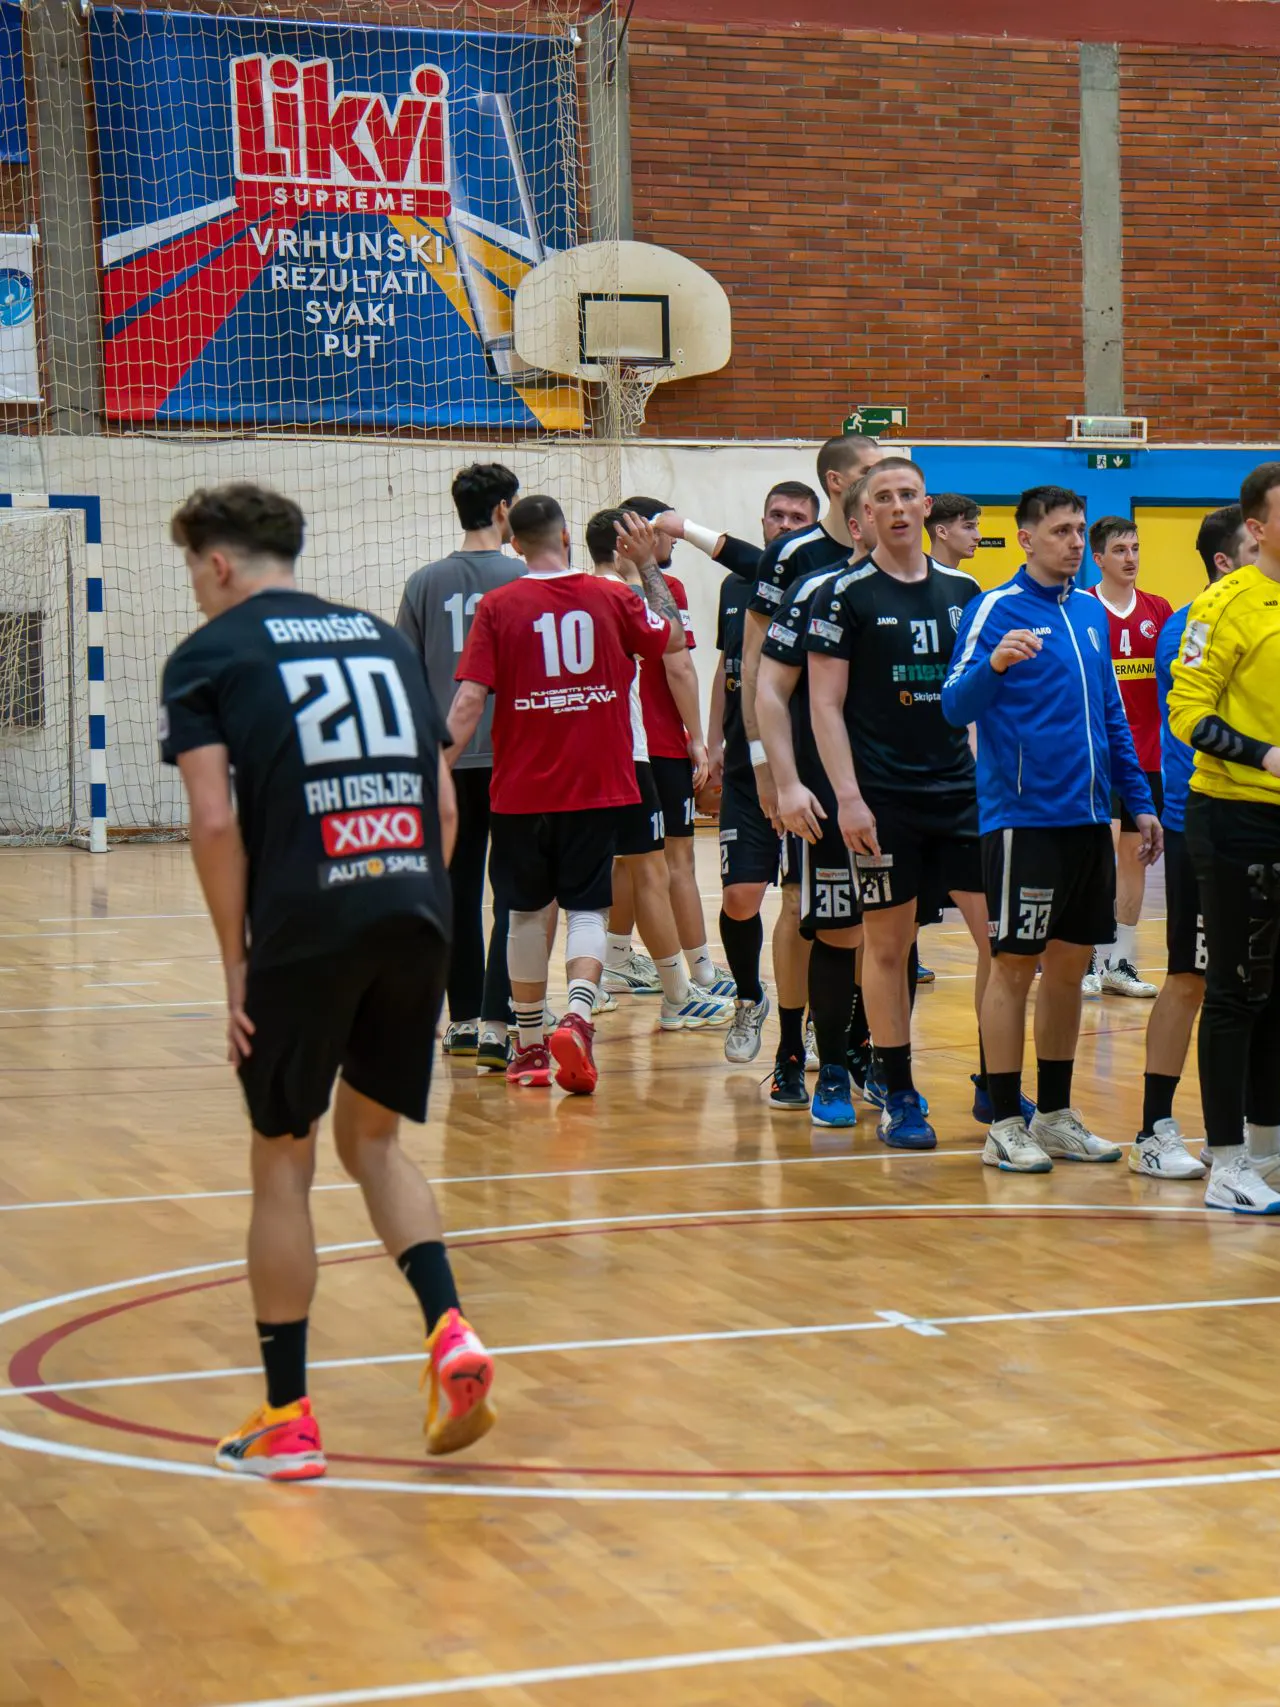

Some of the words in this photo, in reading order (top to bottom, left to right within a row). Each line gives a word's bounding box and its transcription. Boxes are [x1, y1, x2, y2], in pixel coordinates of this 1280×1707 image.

[273, 187, 416, 212] SUPREME
[250, 227, 445, 264] VRHUNSKI
[271, 266, 428, 296] REZULTATI
[305, 300, 396, 327] SVAKI
[323, 333, 382, 360] PUT
[877, 617, 899, 626] JAKO
[910, 619, 940, 654] 31
[533, 609, 595, 678] 10
[1119, 628, 1132, 656] 4
[907, 664, 950, 682] nex
[278, 656, 420, 766] 20
[514, 690, 618, 711] DUBRAVA
[330, 811, 418, 852] XIXO
[815, 883, 852, 918] 36
[1016, 903, 1052, 940] 33
